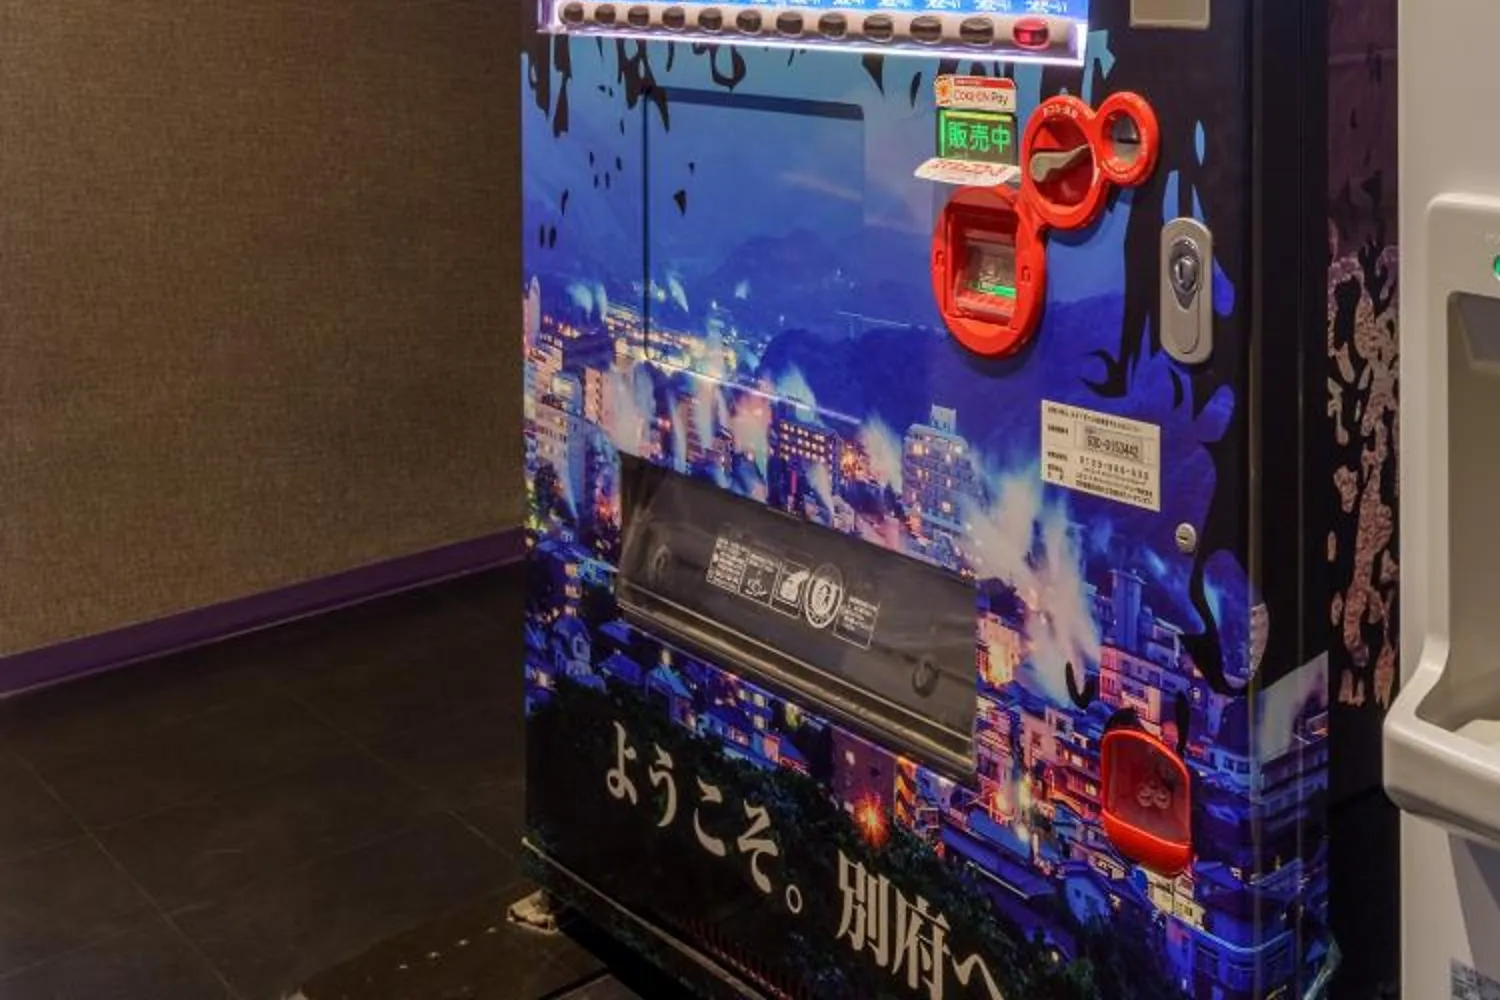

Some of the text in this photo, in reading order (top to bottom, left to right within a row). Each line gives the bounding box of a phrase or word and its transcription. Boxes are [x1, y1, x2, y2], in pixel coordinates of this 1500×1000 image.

[948, 121, 1011, 152] 販売中
[834, 850, 1004, 1000] 別府へ
